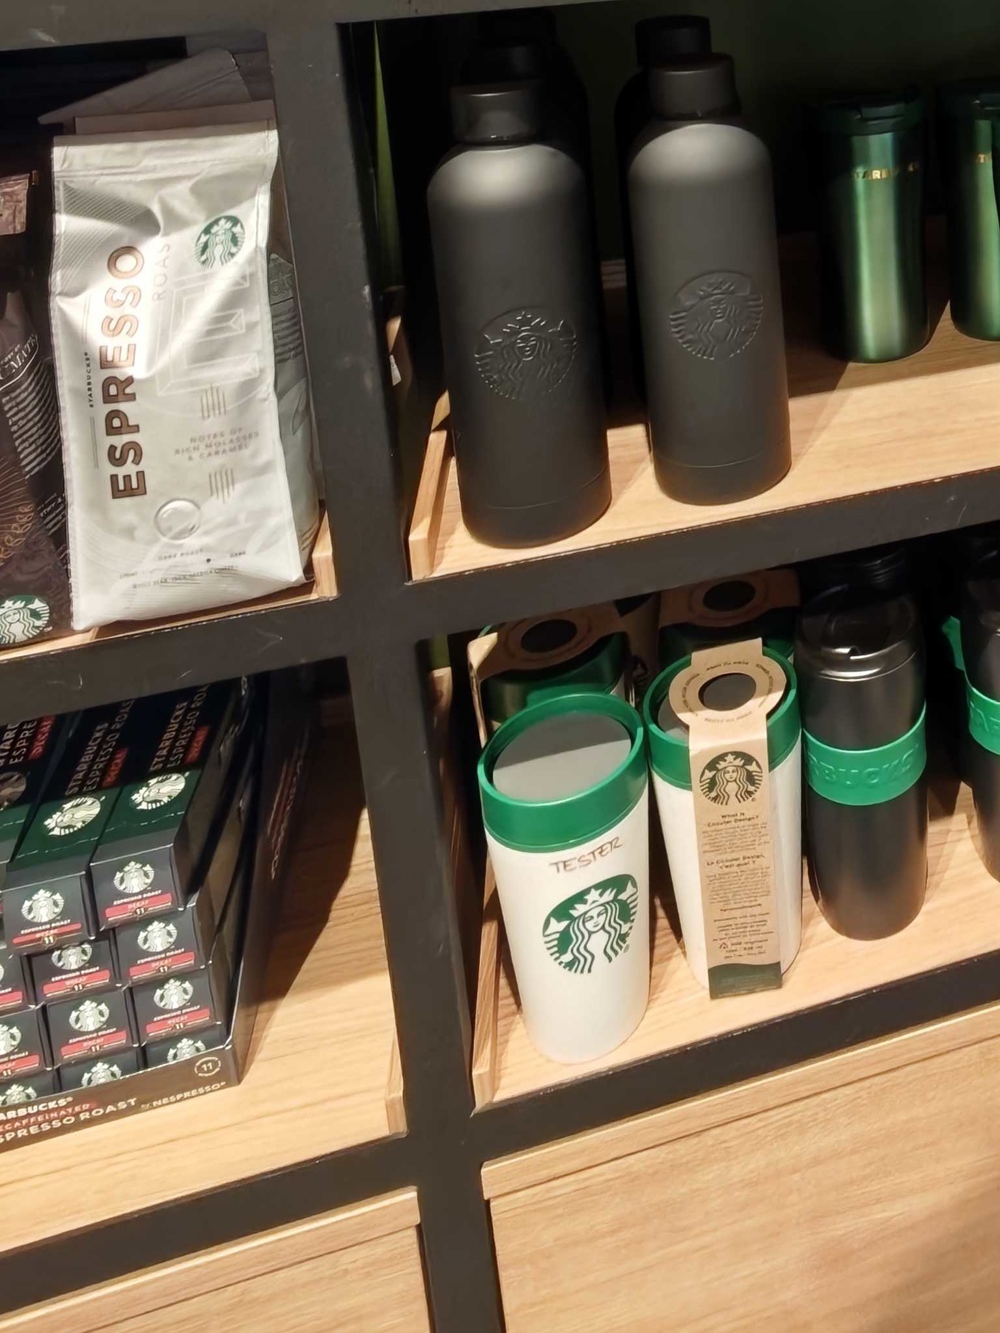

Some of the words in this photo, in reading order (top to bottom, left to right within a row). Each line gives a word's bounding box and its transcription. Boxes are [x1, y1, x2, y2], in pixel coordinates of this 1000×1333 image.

[99, 245, 148, 500] ESPRESSO
[65, 722, 109, 796] STARBUCKS
[83, 732, 119, 791] ESPRESSO
[151, 700, 189, 772] STARBUCKS
[549, 836, 624, 874] TESTER
[201, 1062, 214, 1072] 11
[80, 1097, 138, 1121] ROAST
